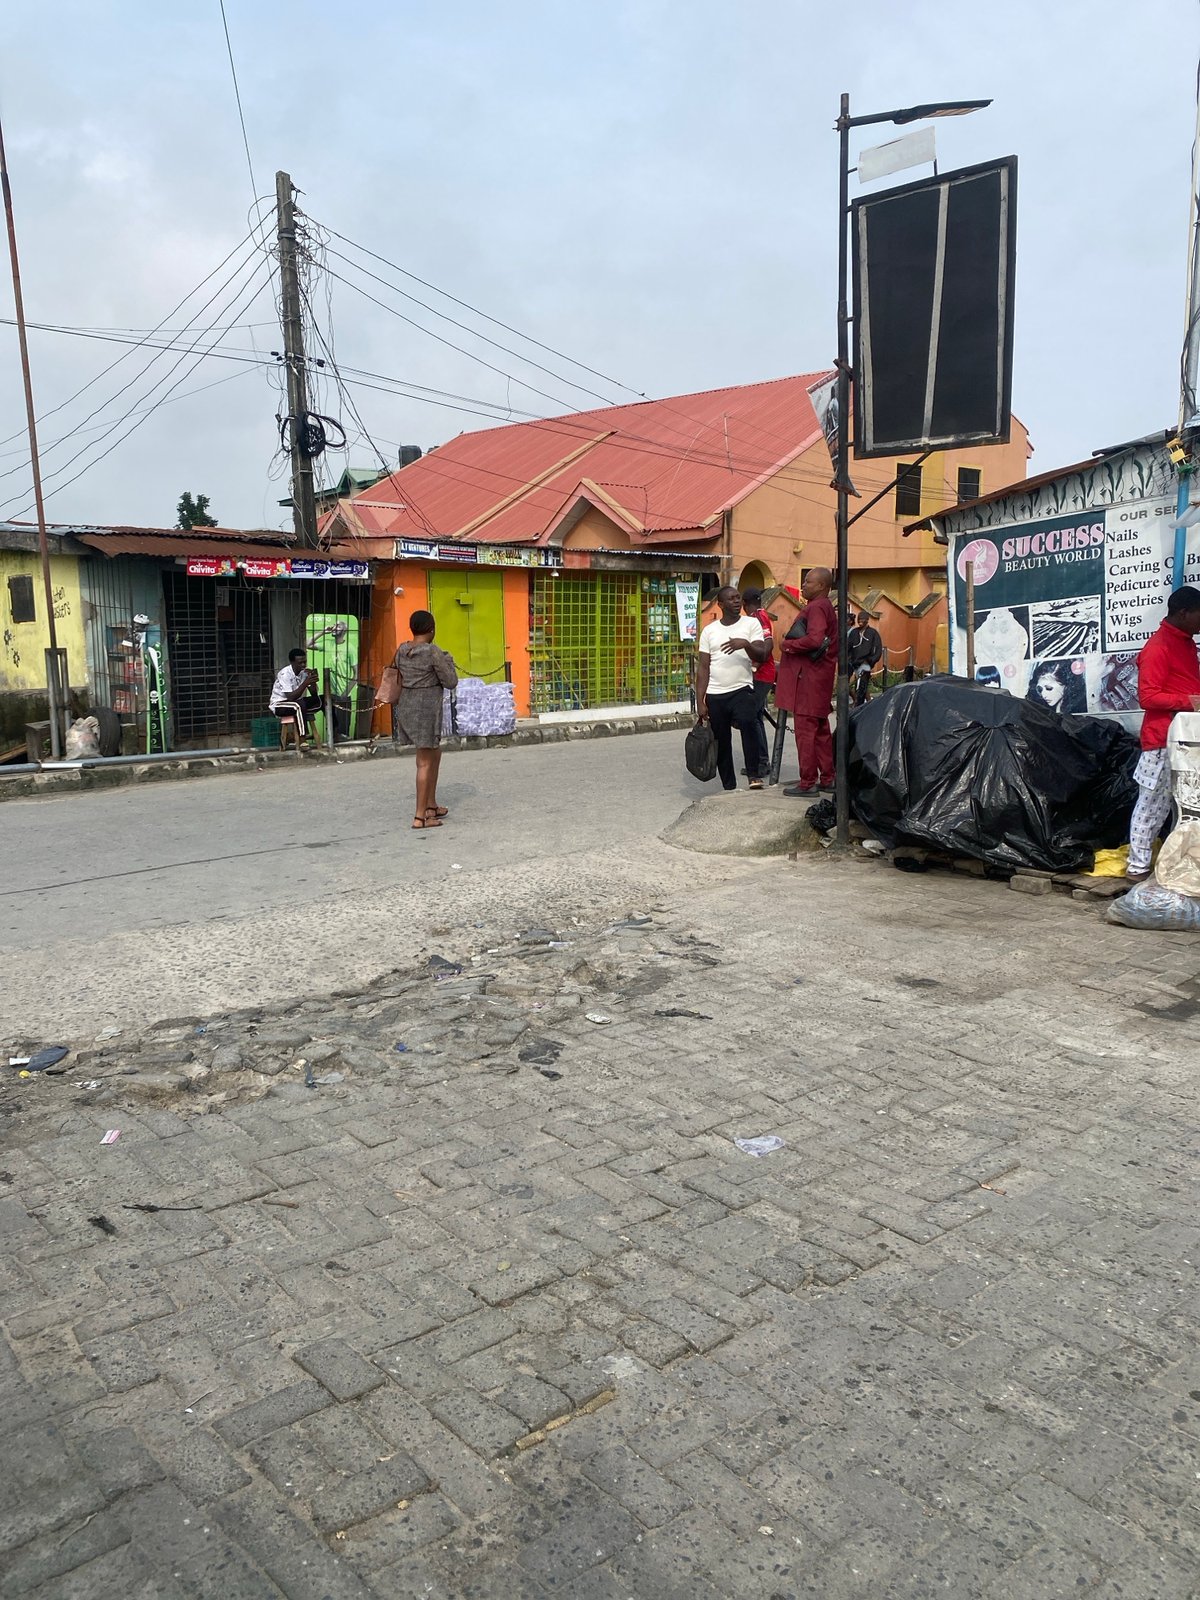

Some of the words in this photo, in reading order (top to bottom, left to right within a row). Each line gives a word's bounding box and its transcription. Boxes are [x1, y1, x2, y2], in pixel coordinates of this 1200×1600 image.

[1120, 510, 1148, 522] OUR
[1002, 523, 1105, 560] SUCCESS
[1105, 529, 1139, 544] Nails
[408, 543, 430, 553] VENTURES
[1108, 545, 1152, 560] Lashes
[1004, 555, 1052, 573] BEAUTY
[1054, 547, 1101, 565] WORLD
[189, 564, 216, 574] Chivita
[246, 566, 271, 575] Chivita
[1109, 560, 1161, 576] Carving
[1106, 578, 1160, 594] Pedicure
[1163, 573, 1174, 586] &
[684, 603, 698, 611] SOL
[1105, 594, 1164, 611] Jewelries
[685, 612, 697, 620] HE
[1110, 613, 1143, 628] Wigs
[1106, 630, 1157, 644] Makeu
